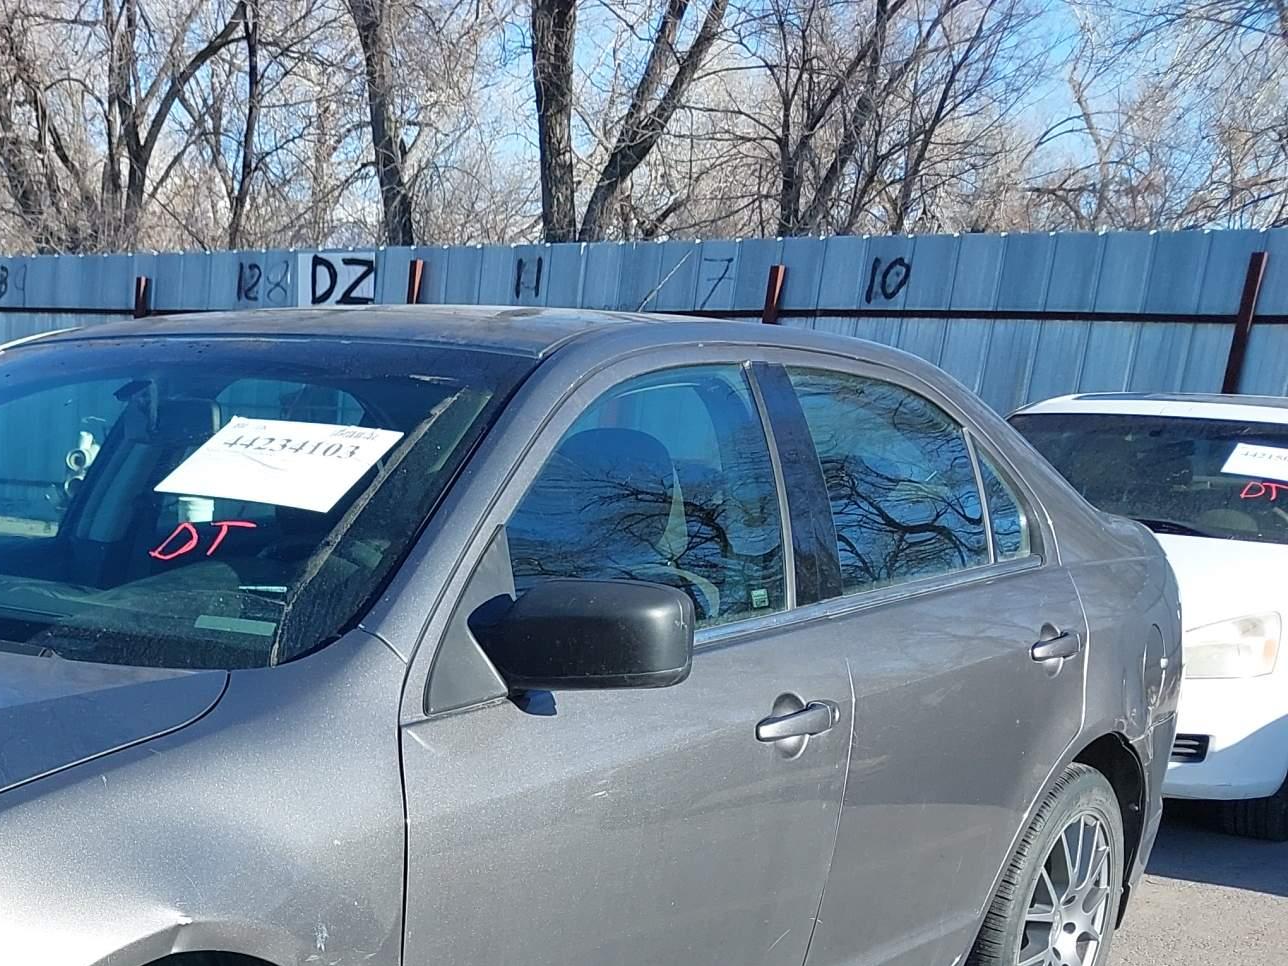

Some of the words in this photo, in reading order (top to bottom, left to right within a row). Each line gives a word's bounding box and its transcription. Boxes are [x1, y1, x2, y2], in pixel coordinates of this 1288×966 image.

[311, 254, 376, 305] DZ
[865, 256, 911, 304] 10
[223, 434, 360, 459] 44234103
[1240, 481, 1288, 501] DT
[150, 522, 256, 559] DT
